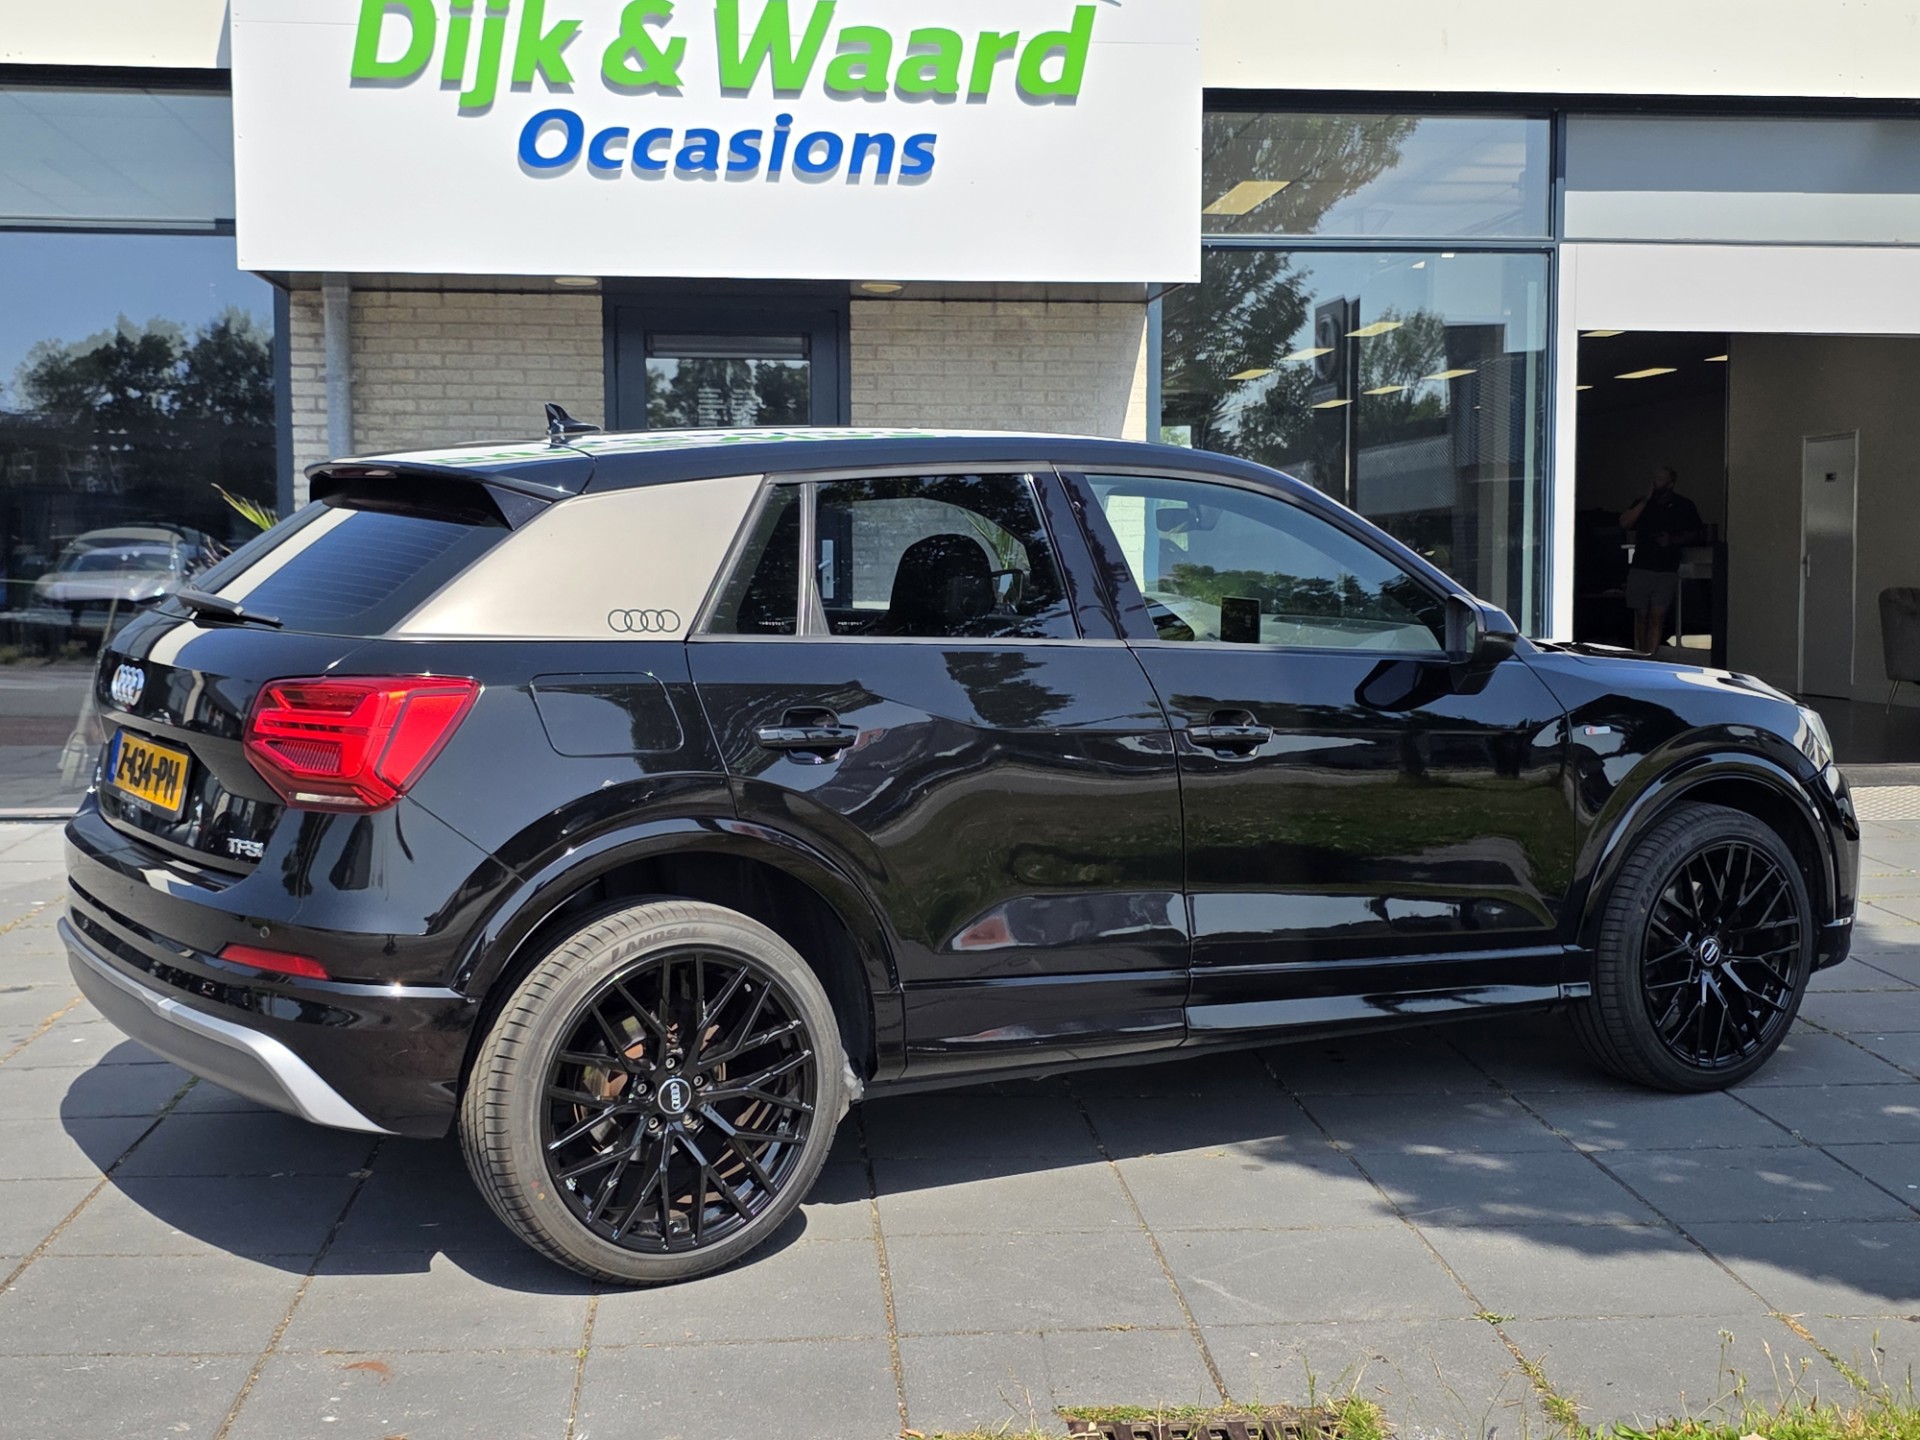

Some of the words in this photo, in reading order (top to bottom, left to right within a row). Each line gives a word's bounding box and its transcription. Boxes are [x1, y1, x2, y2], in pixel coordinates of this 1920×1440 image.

[350, 0, 584, 110] Dijk
[601, 0, 687, 90] &
[715, 0, 1097, 98] Waard
[518, 108, 938, 178] Occasions
